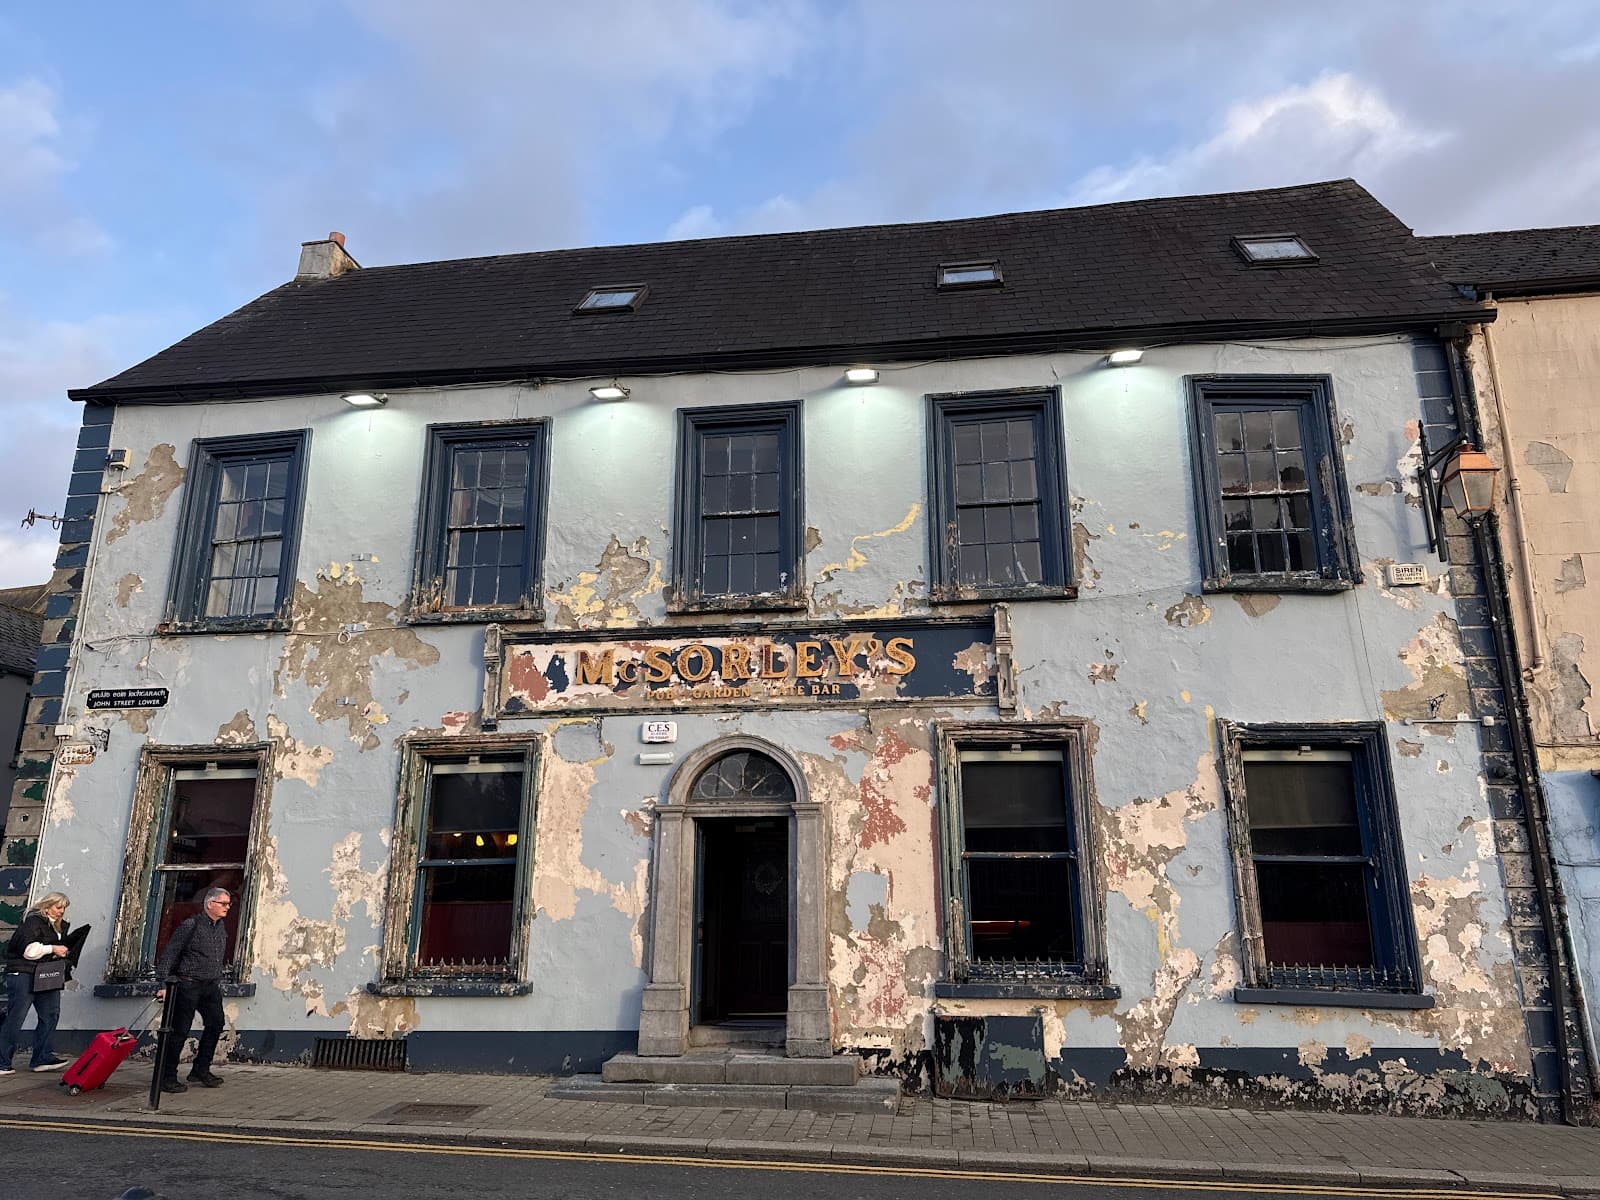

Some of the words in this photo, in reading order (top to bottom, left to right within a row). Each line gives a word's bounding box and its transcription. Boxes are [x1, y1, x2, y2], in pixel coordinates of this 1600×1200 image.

[692, 687, 750, 699] GARDEN
[769, 685, 805, 696] LATE
[811, 684, 841, 695] BAR
[93, 700, 111, 708] JOHN
